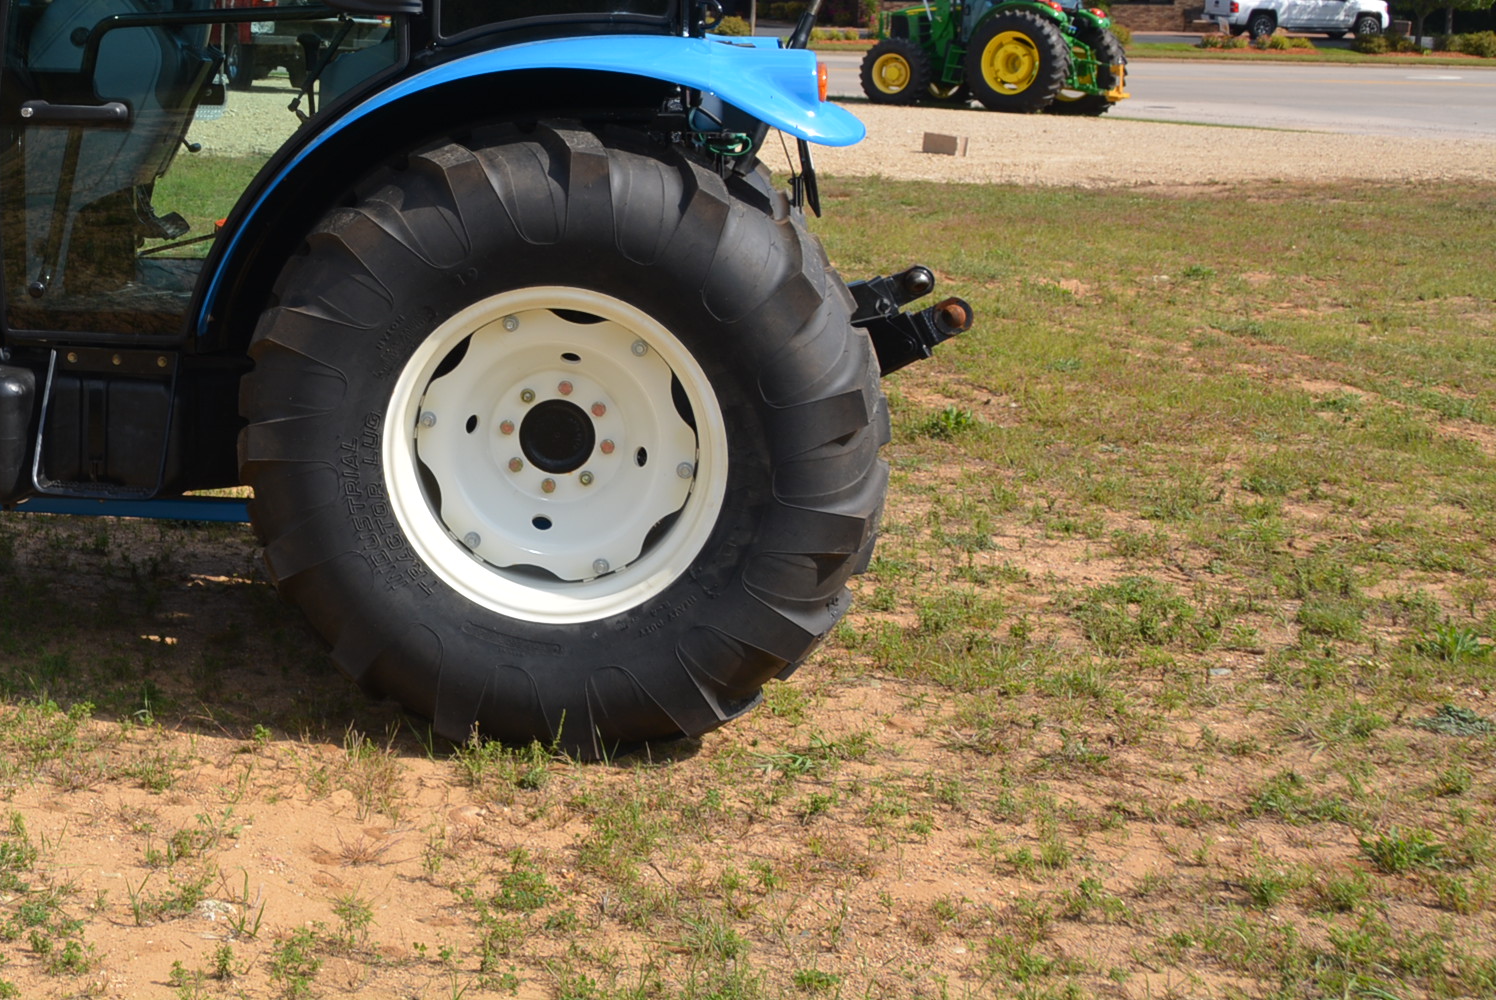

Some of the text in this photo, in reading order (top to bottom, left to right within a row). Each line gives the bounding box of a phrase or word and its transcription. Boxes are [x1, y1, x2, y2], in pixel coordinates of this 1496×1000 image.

[340, 436, 409, 592] INDUSTRIAL
[362, 410, 438, 597] TRACTOR LUG
